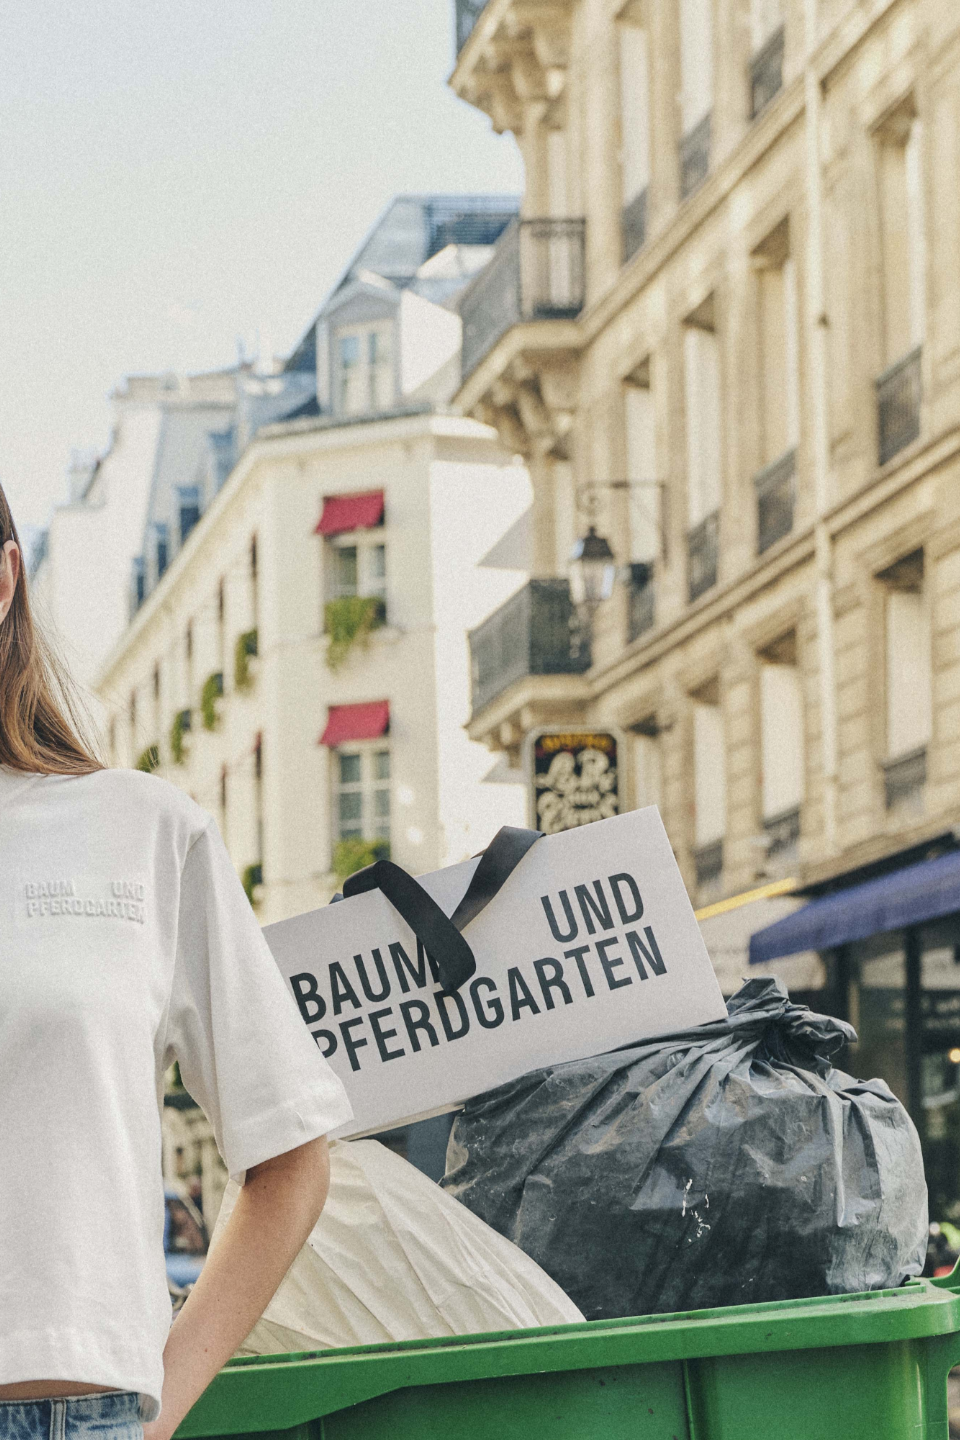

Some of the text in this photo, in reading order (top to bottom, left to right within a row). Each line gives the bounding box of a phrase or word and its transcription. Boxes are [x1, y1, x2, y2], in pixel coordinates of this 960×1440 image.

[26, 880, 75, 899] BAUM
[289, 872, 644, 1025] BAUM UND
[311, 926, 668, 1072] PFERDGARTEN
